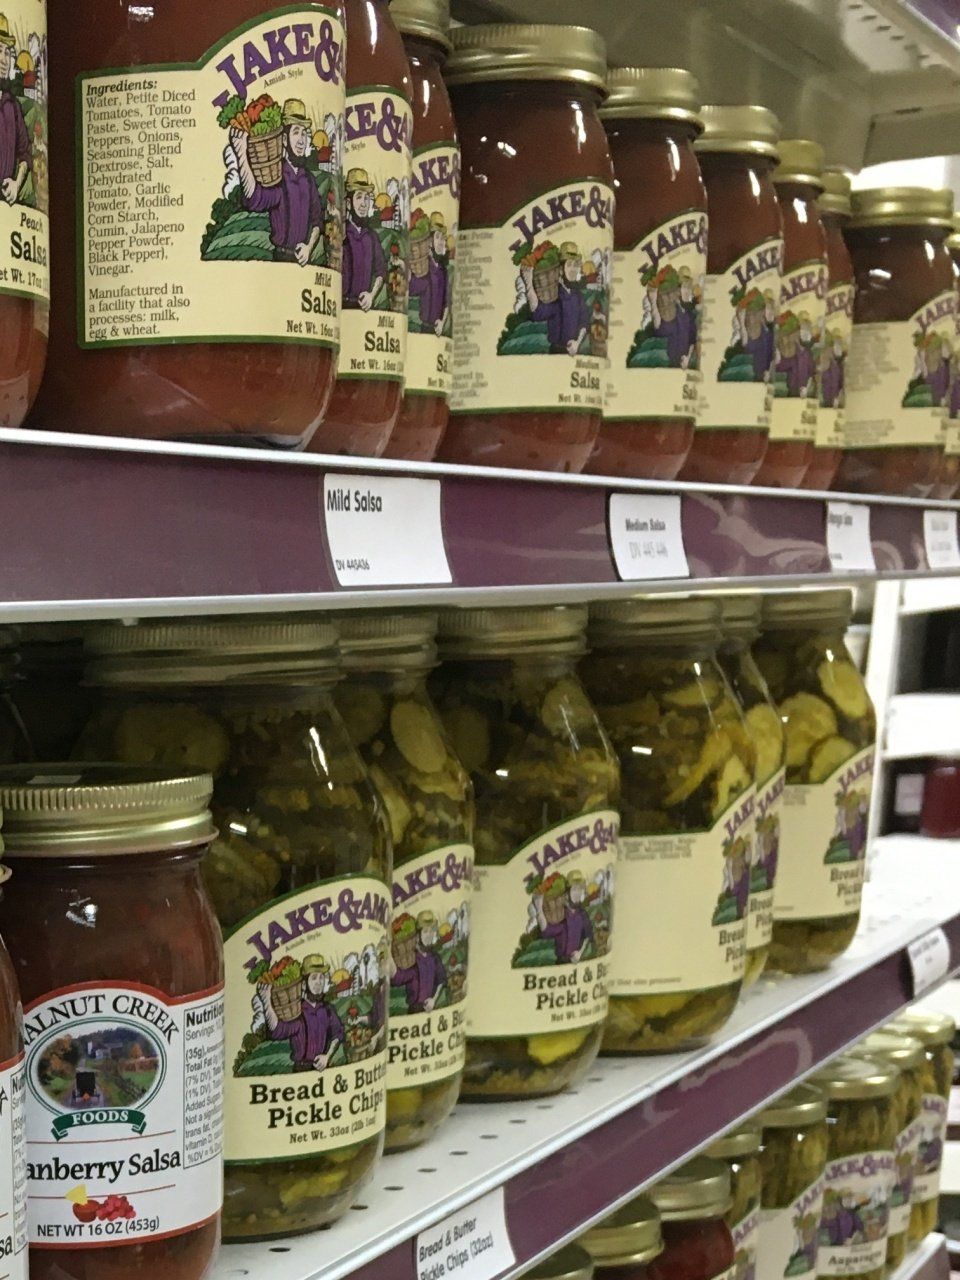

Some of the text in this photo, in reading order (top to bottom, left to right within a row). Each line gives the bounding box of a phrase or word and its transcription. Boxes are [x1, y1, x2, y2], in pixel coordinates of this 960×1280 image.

[86, 79, 159, 96] Ingredients:
[86, 89, 196, 108] Water, Petite Diced
[86, 104, 192, 122] Tomatoes, Tomato
[86, 116, 197, 135] Paste, Sweet Green
[86, 131, 184, 149] Peppers, Onions,
[86, 143, 182, 161] Seasoning Blend
[145, 156, 174, 170] Salt,
[87, 171, 153, 187] Dehydrated
[87, 182, 171, 200] Tomato, Garlic
[87, 194, 184, 213] Powder, Modified
[314, 271, 333, 288] Mild
[89, 284, 170, 300] Manufactured
[98, 297, 191, 315] facility that also
[300, 288, 338, 318] Salsa
[363, 330, 402, 354] Salsa
[569, 371, 601, 391] Salsa
[326, 488, 384, 514] Mild Salsa
[624, 517, 667, 533] Medium Salsa
[522, 967, 578, 992] Bread
[535, 987, 590, 1012] Pickle
[112, 993, 181, 1045] CREEK
[388, 1037, 445, 1064] Pickle
[248, 1076, 325, 1106] Bread
[332, 1073, 350, 1094] &
[71, 1109, 131, 1127] FOODS
[267, 1098, 343, 1130] Pickle
[289, 1121, 351, 1145] Net Wt. 33oz
[26, 1148, 182, 1184] anberry Salsa
[36, 1215, 161, 1238] NET WT 16 OZ (453g)
[418, 1217, 478, 1264] Bread & Butter
[446, 1246, 470, 1272] Chips
